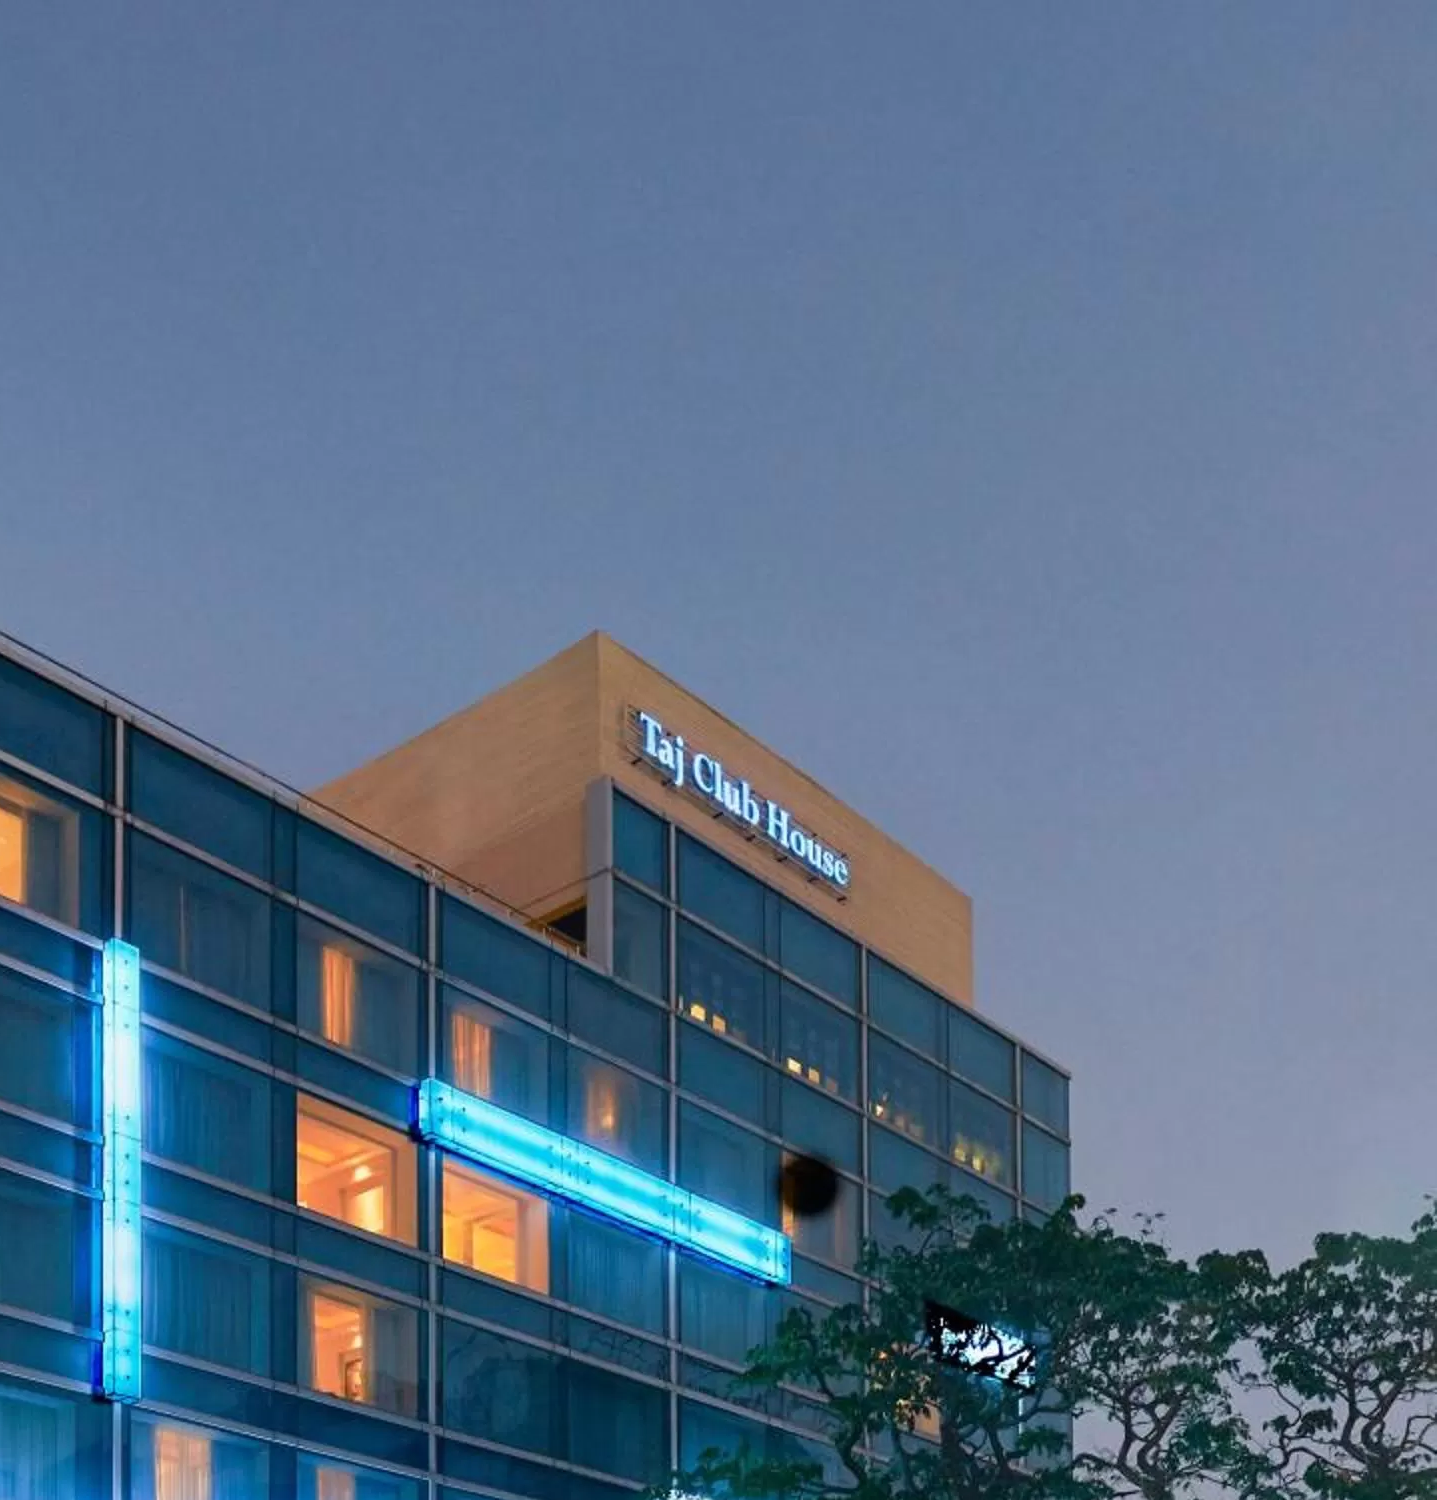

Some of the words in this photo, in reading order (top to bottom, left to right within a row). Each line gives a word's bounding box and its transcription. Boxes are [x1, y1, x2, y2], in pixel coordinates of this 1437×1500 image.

[639, 711, 685, 788] Taj
[693, 753, 760, 826] Club
[766, 799, 850, 886] House
